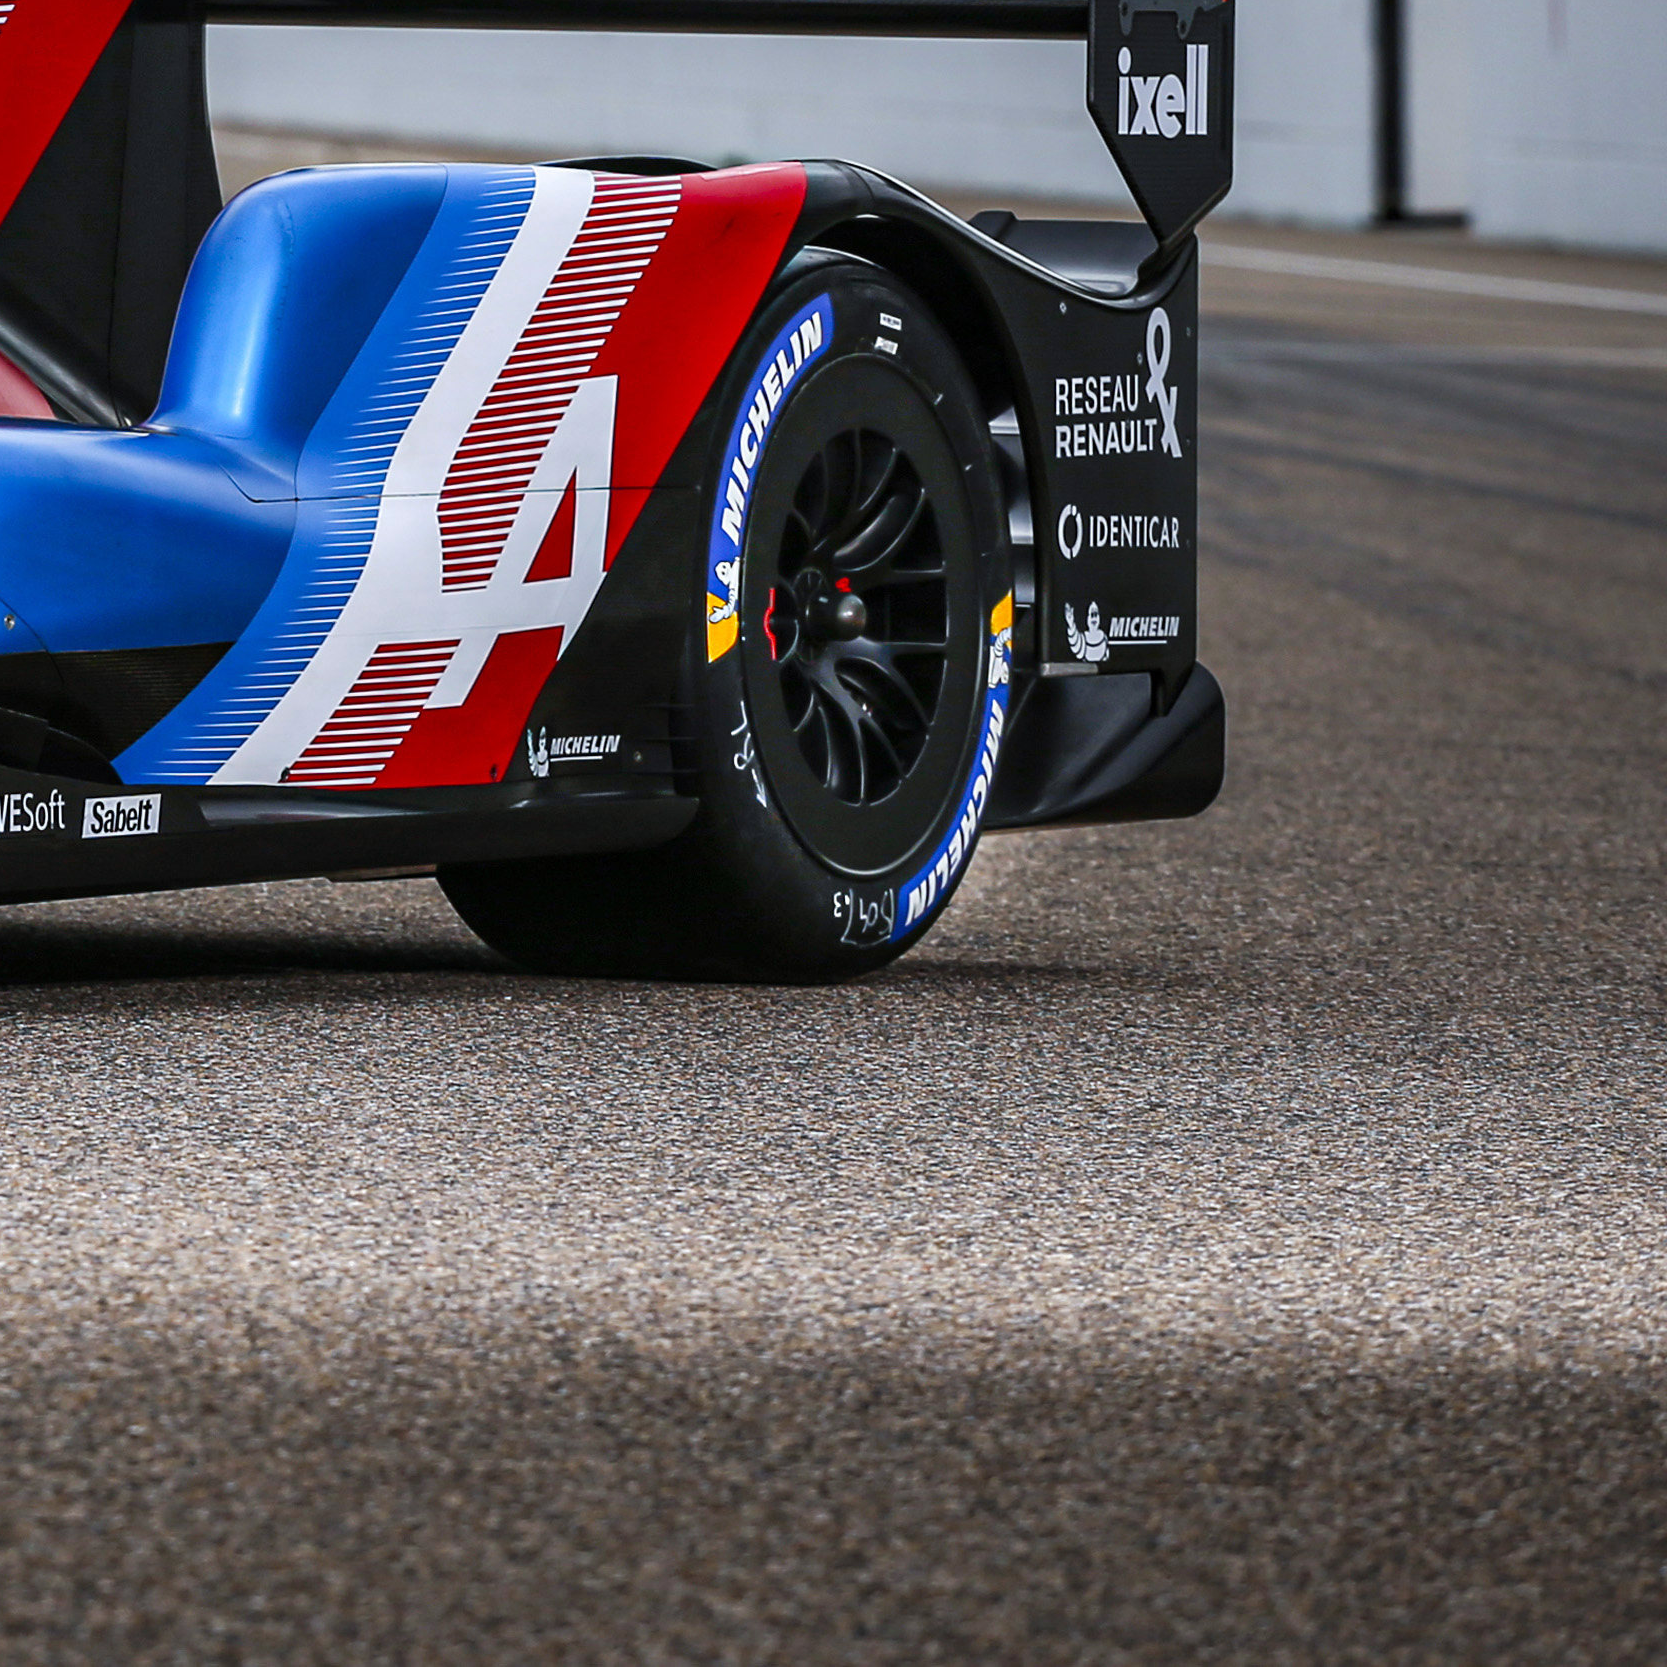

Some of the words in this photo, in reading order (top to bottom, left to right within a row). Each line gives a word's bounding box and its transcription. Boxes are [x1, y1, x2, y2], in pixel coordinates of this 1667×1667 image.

[1117, 44, 1209, 139] ixell
[1055, 374, 1139, 414] RESEAU
[723, 311, 825, 546] MICHELIN
[1055, 418, 1157, 459] RENAULT
[1088, 512, 1180, 550] IDENTICAR
[1108, 616, 1180, 638] MICHELIN
[550, 735, 620, 754] MICHELIN
[90, 799, 153, 833] Sabelt
[904, 699, 1005, 926] MICHELIN
